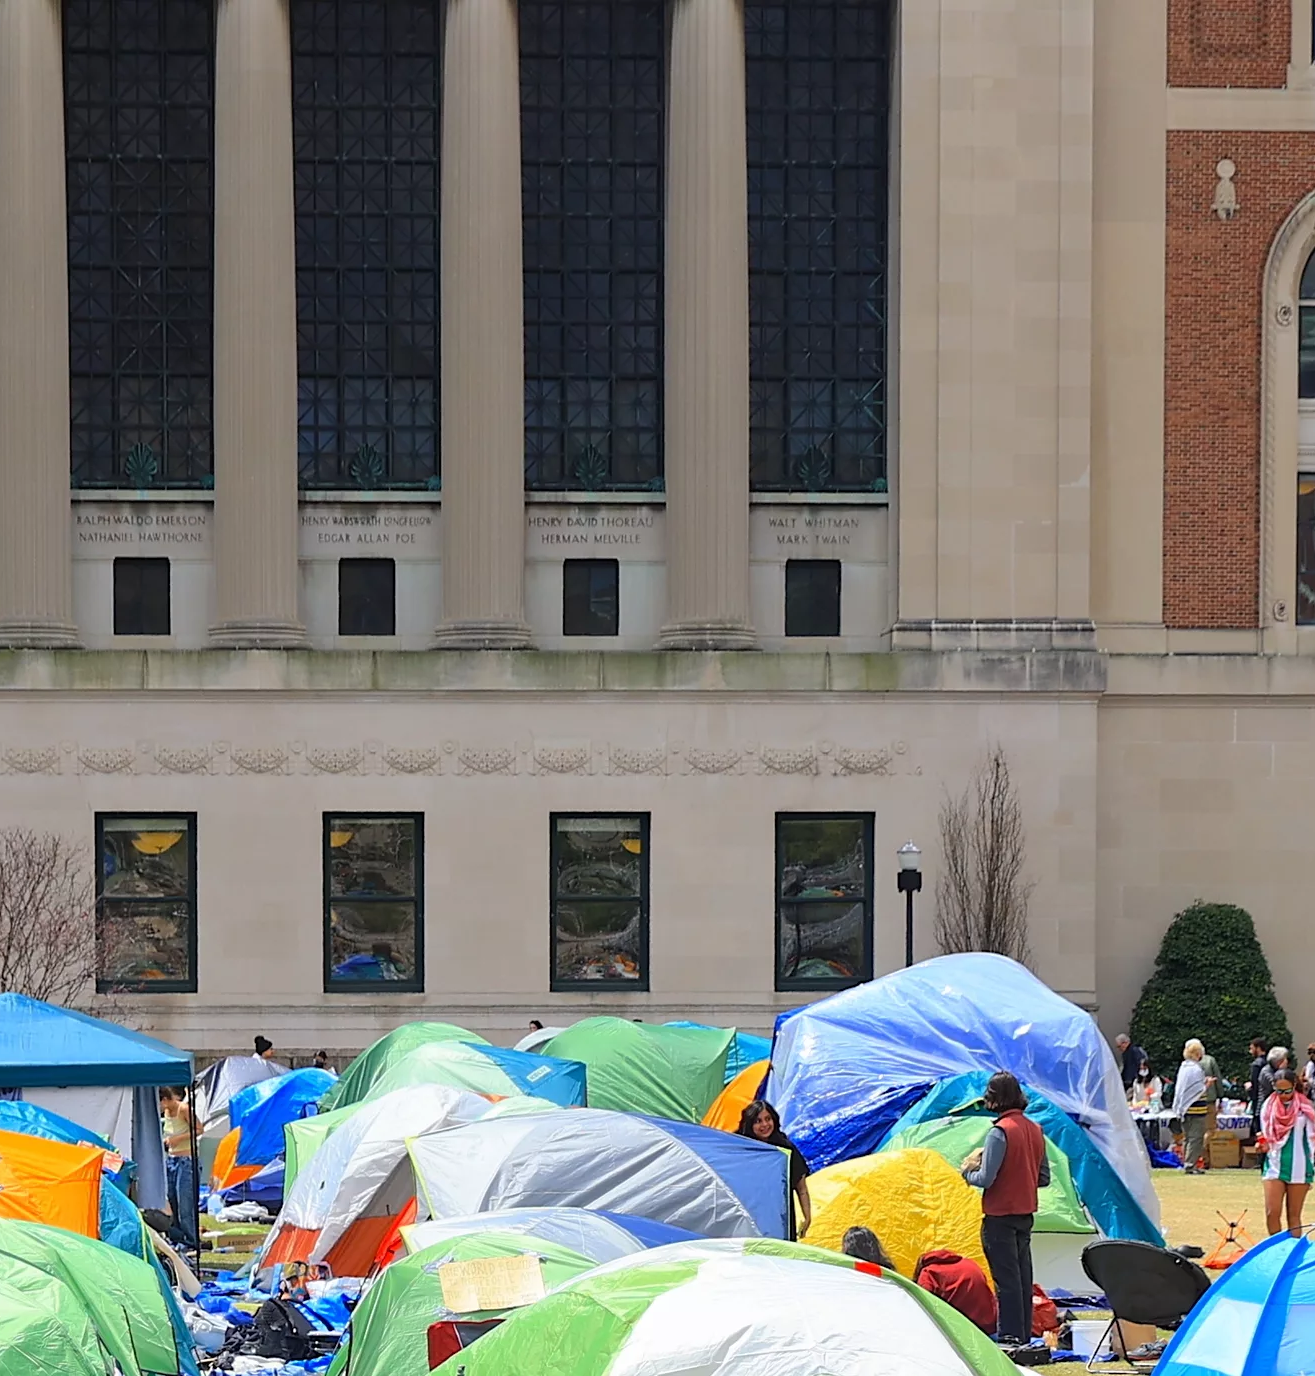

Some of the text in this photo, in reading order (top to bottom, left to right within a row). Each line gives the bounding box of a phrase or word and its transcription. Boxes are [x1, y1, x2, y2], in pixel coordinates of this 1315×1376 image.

[77, 516, 205, 525] RALPH WALDO EMERSON
[302, 516, 330, 526] HENRY
[528, 517, 654, 528] HENRY DAVID THOREAU
[769, 518, 859, 528] WALT WHITMAN
[79, 532, 203, 542] NATHANIEL HAWTHORNE
[318, 533, 415, 543] EDGAR ALLAN POE
[542, 534, 642, 544] HERMAN MELVILLE
[777, 535, 851, 544] MARK TWAIN
